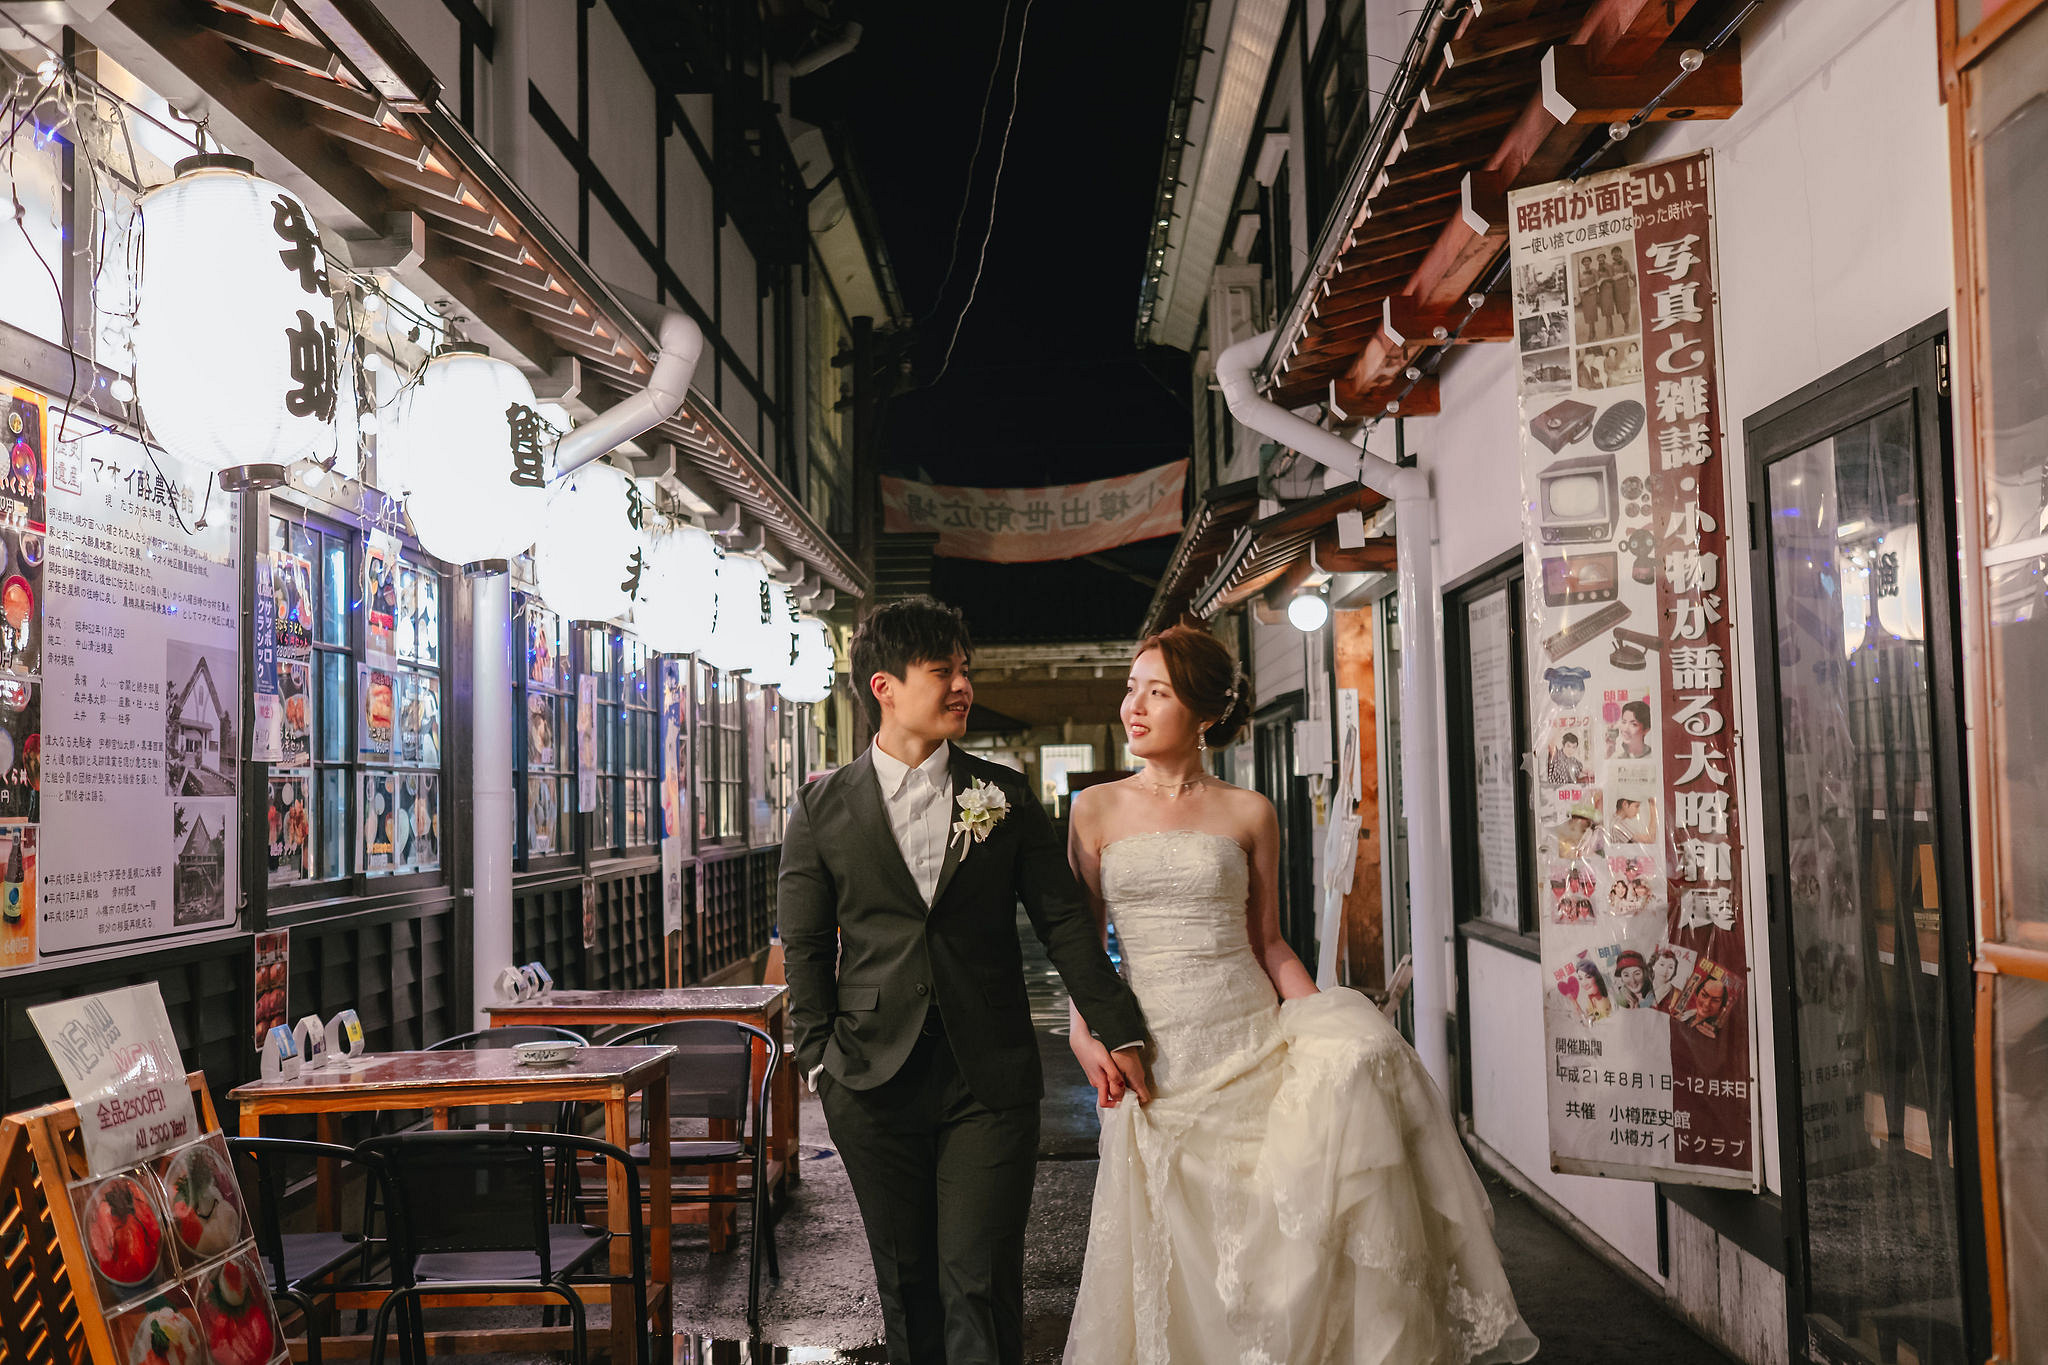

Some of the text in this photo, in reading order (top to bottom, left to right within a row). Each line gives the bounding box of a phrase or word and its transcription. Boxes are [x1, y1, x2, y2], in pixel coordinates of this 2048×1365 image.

[1565, 1100, 1691, 1130] 共催 小樽歴史館
[1609, 1127, 1745, 1158] 小樽ガイドクラブ
